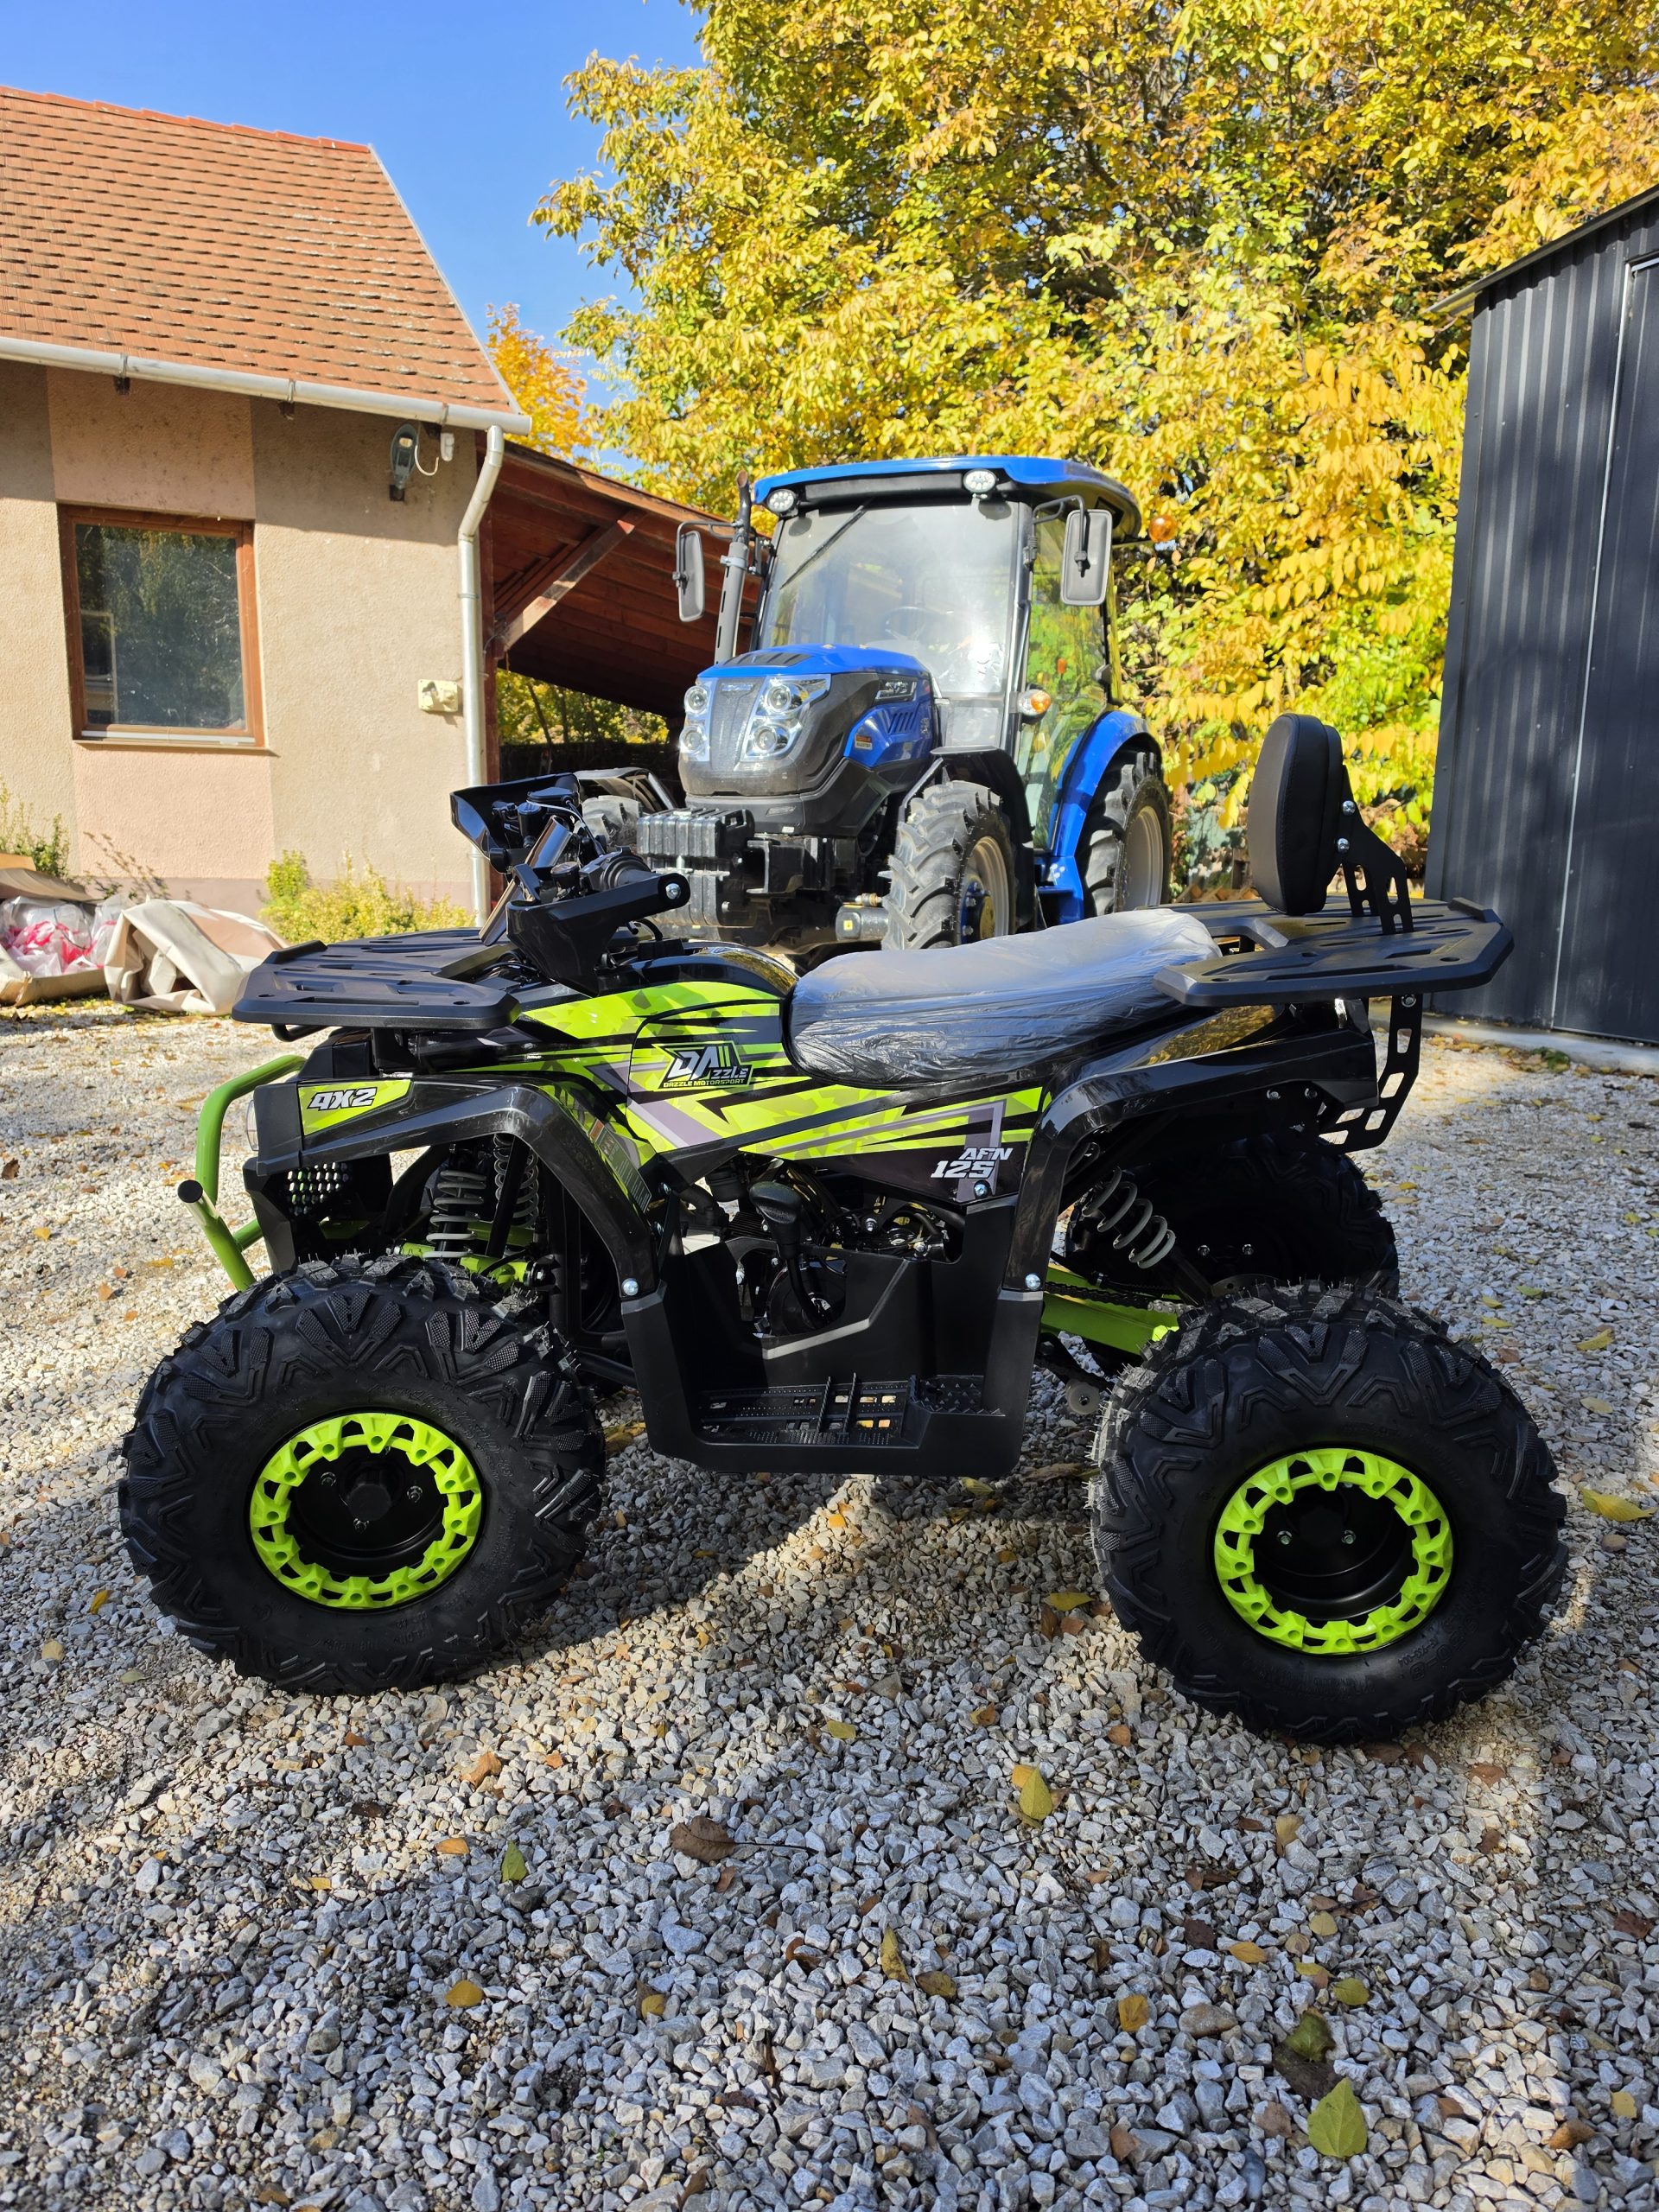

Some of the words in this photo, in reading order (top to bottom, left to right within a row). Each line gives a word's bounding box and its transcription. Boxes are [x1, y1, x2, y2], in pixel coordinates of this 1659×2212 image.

[694, 1077, 745, 1087] MOTORSPORT
[958, 1147, 1014, 1161] AFN
[930, 1160, 995, 1179] 125
